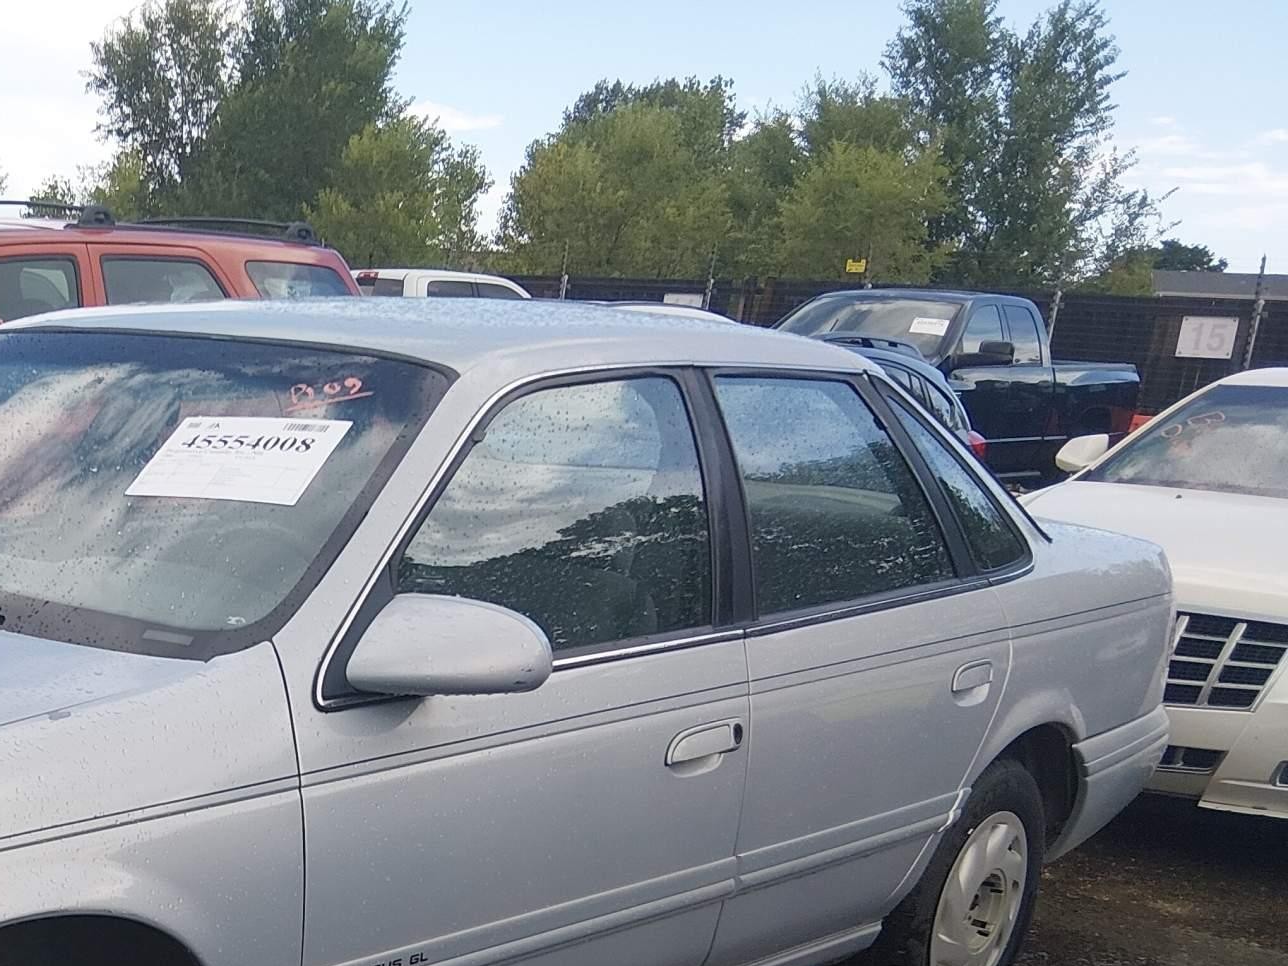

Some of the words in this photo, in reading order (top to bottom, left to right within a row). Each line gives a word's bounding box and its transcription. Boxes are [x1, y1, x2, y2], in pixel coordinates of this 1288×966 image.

[1191, 323, 1228, 351] 15
[182, 433, 316, 453] 45554008
[409, 952, 428, 965] GL
